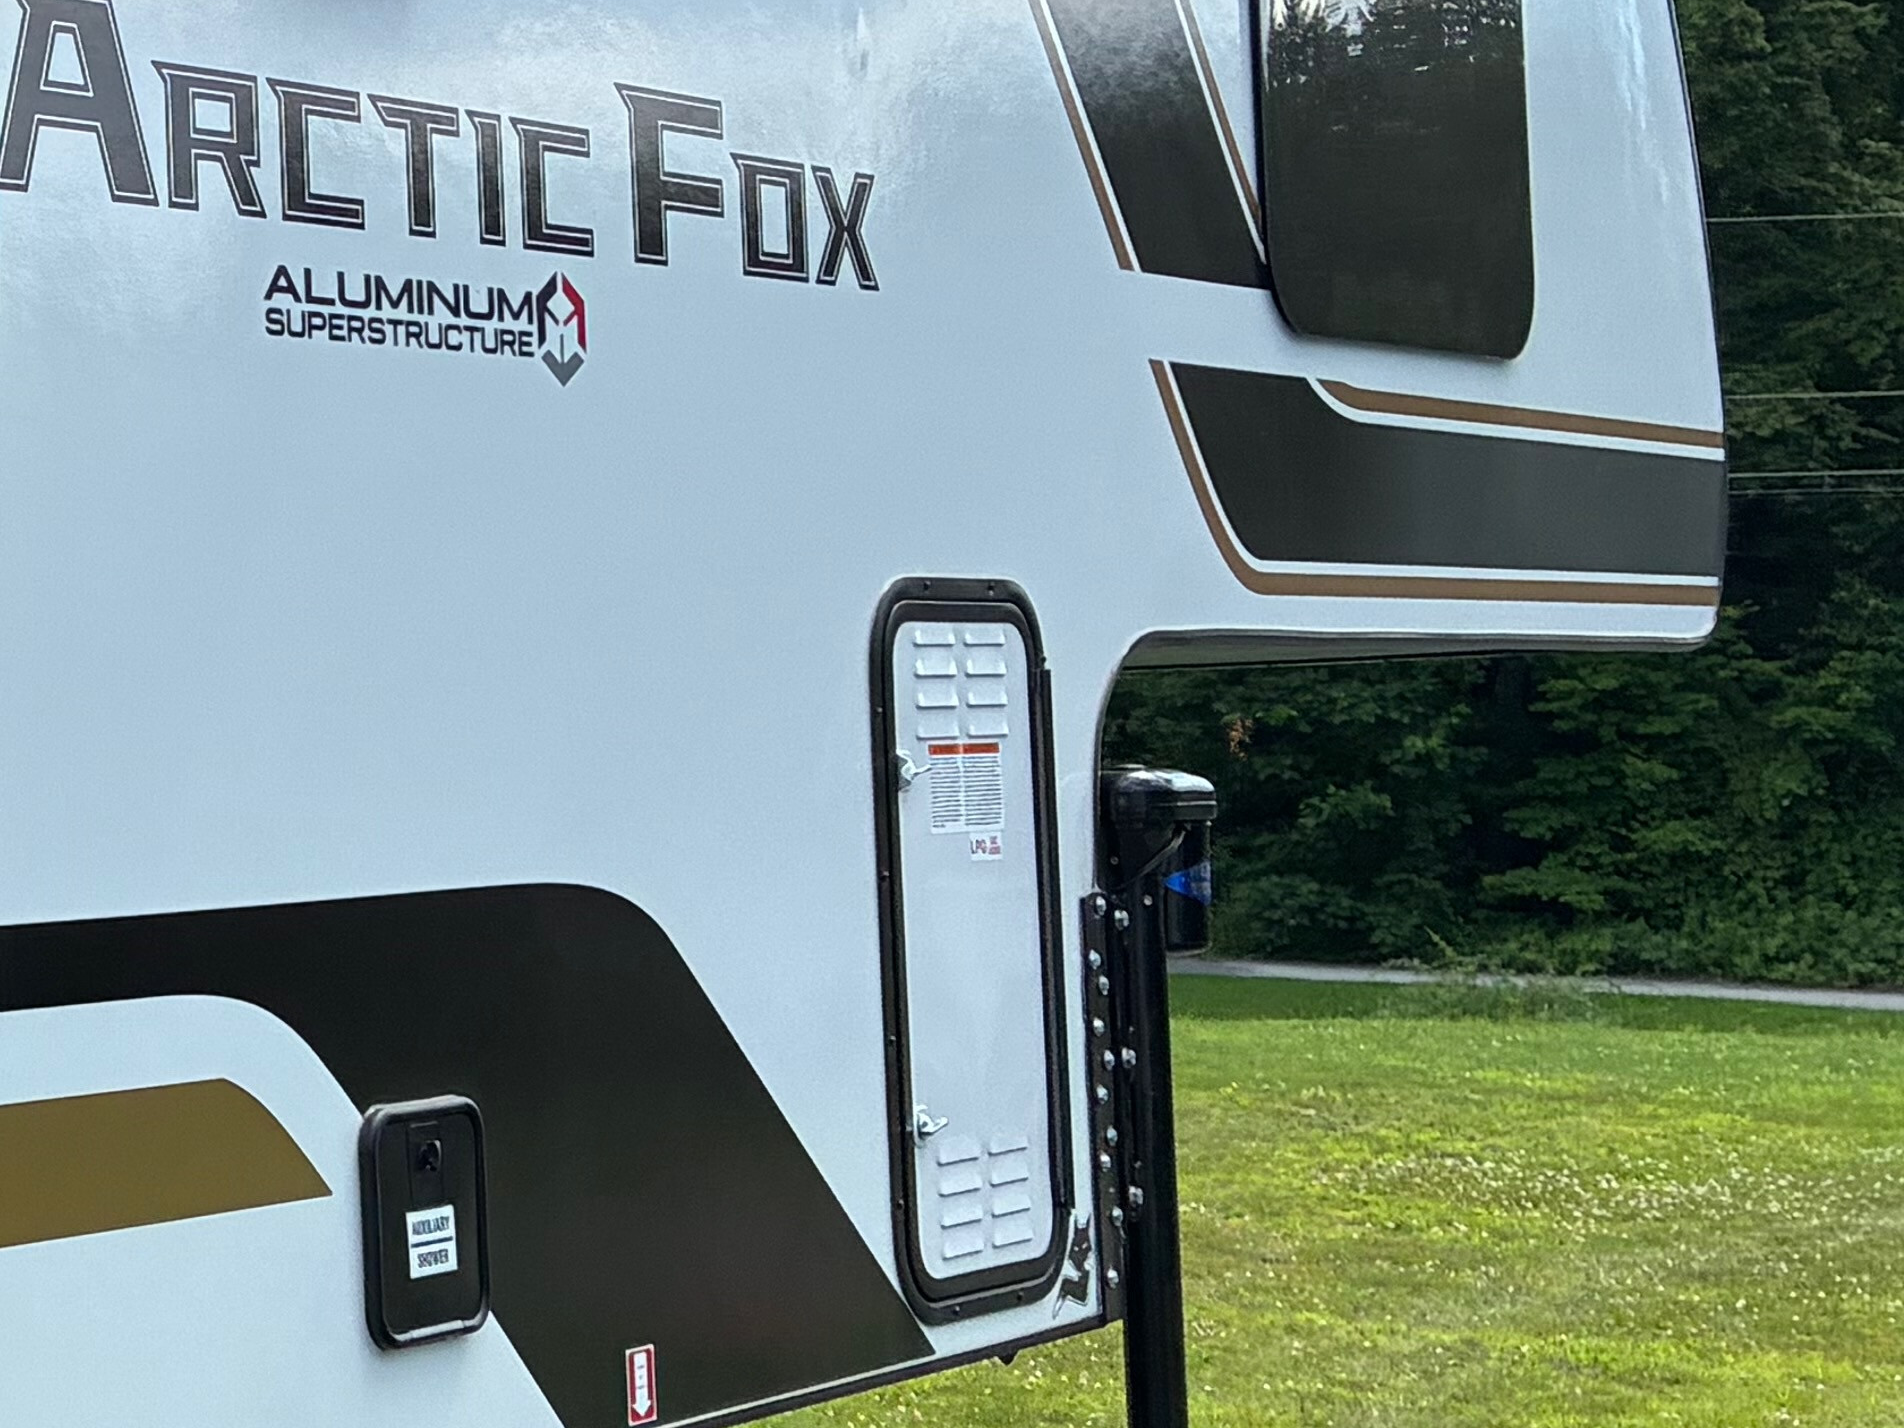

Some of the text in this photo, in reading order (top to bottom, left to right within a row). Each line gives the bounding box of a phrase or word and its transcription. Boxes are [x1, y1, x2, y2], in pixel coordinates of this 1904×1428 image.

[613, 81, 881, 292] FOX
[263, 264, 535, 325] ALUMINUM
[264, 286, 536, 358] SUPERSTRUCTURE
